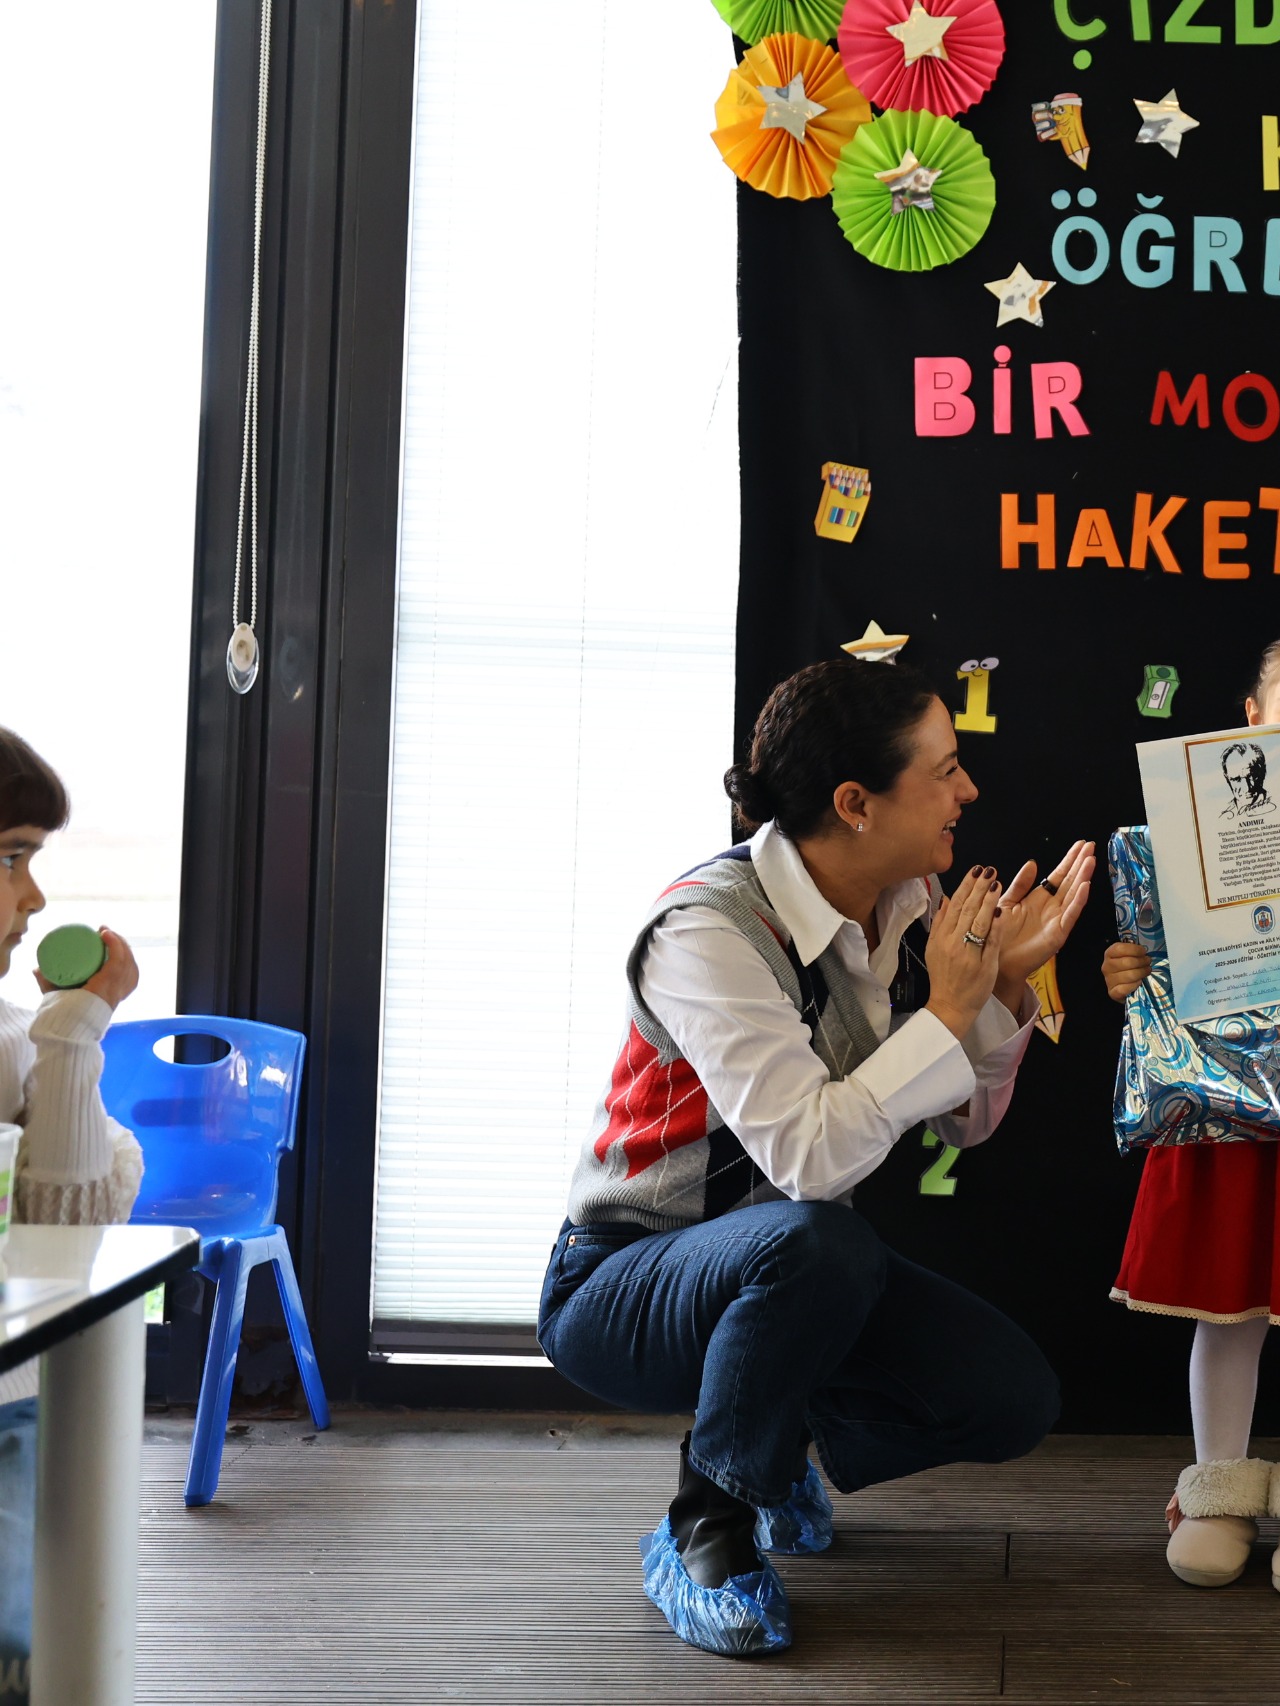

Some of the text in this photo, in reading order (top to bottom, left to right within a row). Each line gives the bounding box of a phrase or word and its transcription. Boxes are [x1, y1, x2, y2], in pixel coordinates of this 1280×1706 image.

[914, 345, 1091, 440] BİR
[1237, 819, 1265, 828] ANDIMIZ
[1249, 888, 1276, 898] TÜRKÜM
[1217, 943, 1242, 952] BELEDİYESİ
[1256, 951, 1277, 959] ÖĞRETİM
[919, 1127, 961, 1196] 2
